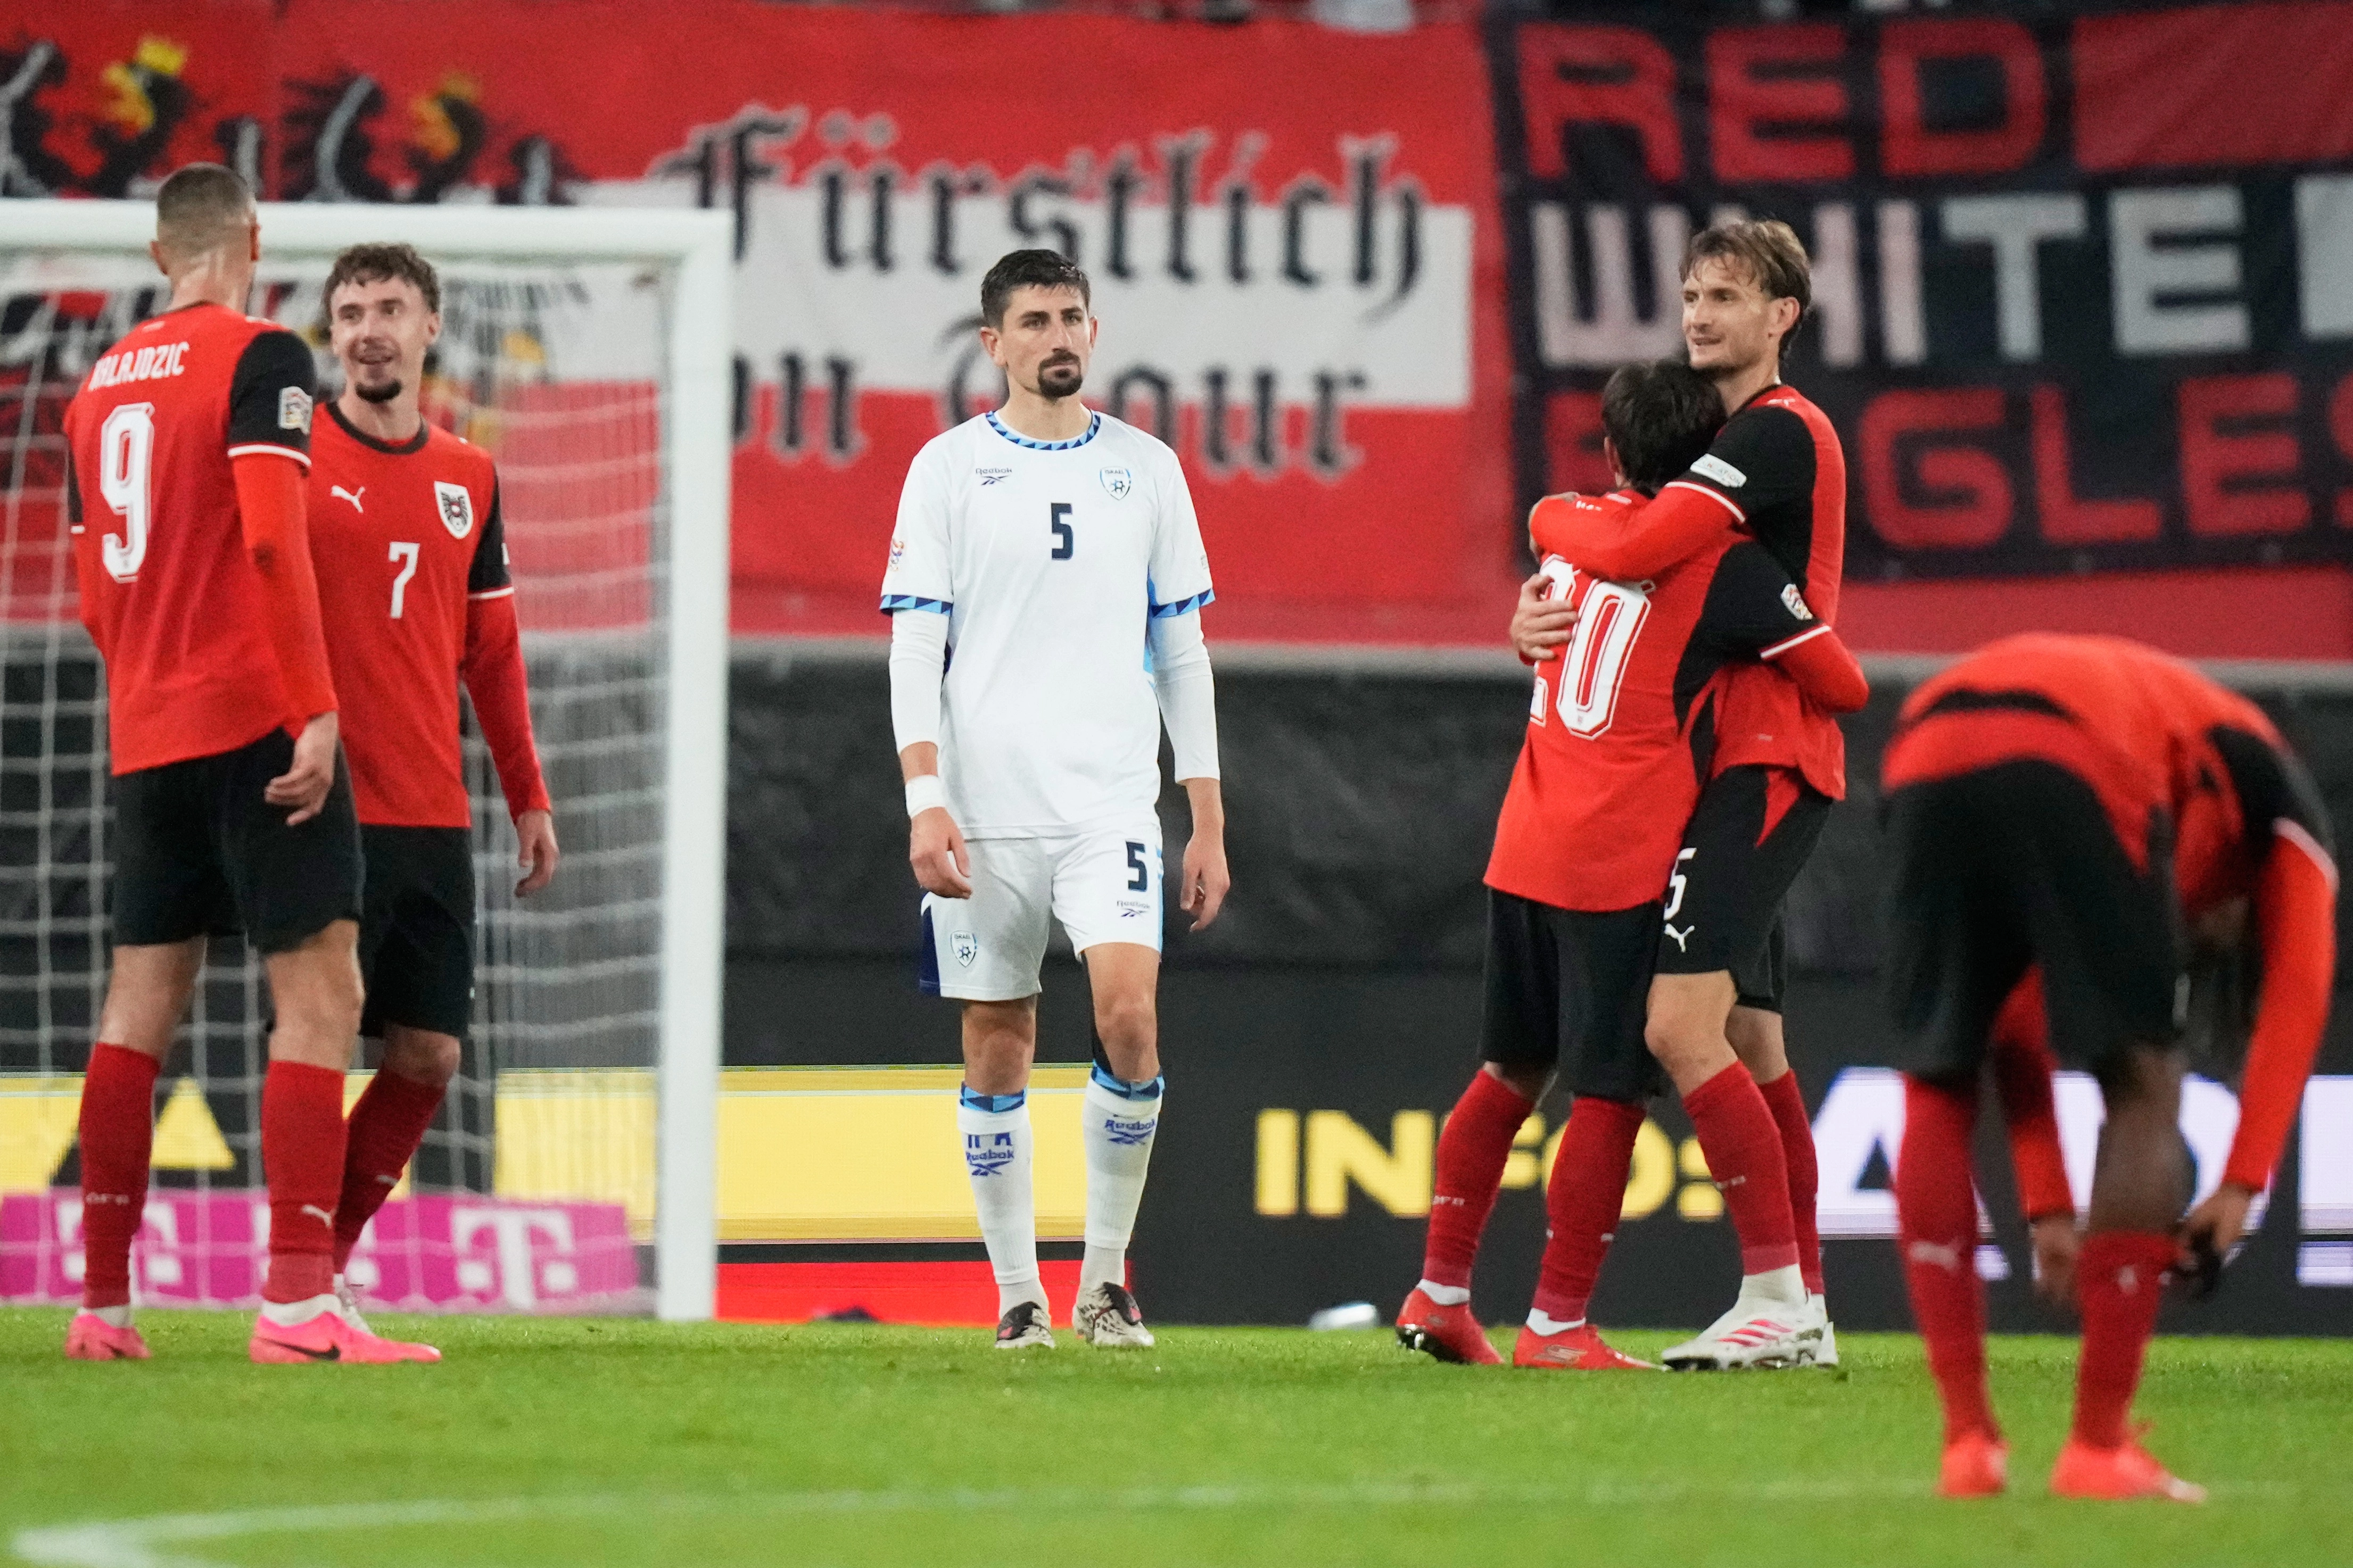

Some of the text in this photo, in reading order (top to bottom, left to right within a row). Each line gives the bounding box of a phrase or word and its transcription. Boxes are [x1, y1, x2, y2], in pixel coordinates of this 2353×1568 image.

[1515, 18, 2048, 182] RED
[646, 101, 1432, 323] Fürstlich
[1531, 184, 2252, 368] WHITE
[100, 401, 155, 583] 9
[1051, 502, 1074, 560] 5
[388, 541, 420, 619] 7
[1125, 841, 1148, 892] 5
[1663, 847, 1697, 921] 5
[450, 1207, 576, 1311] T
